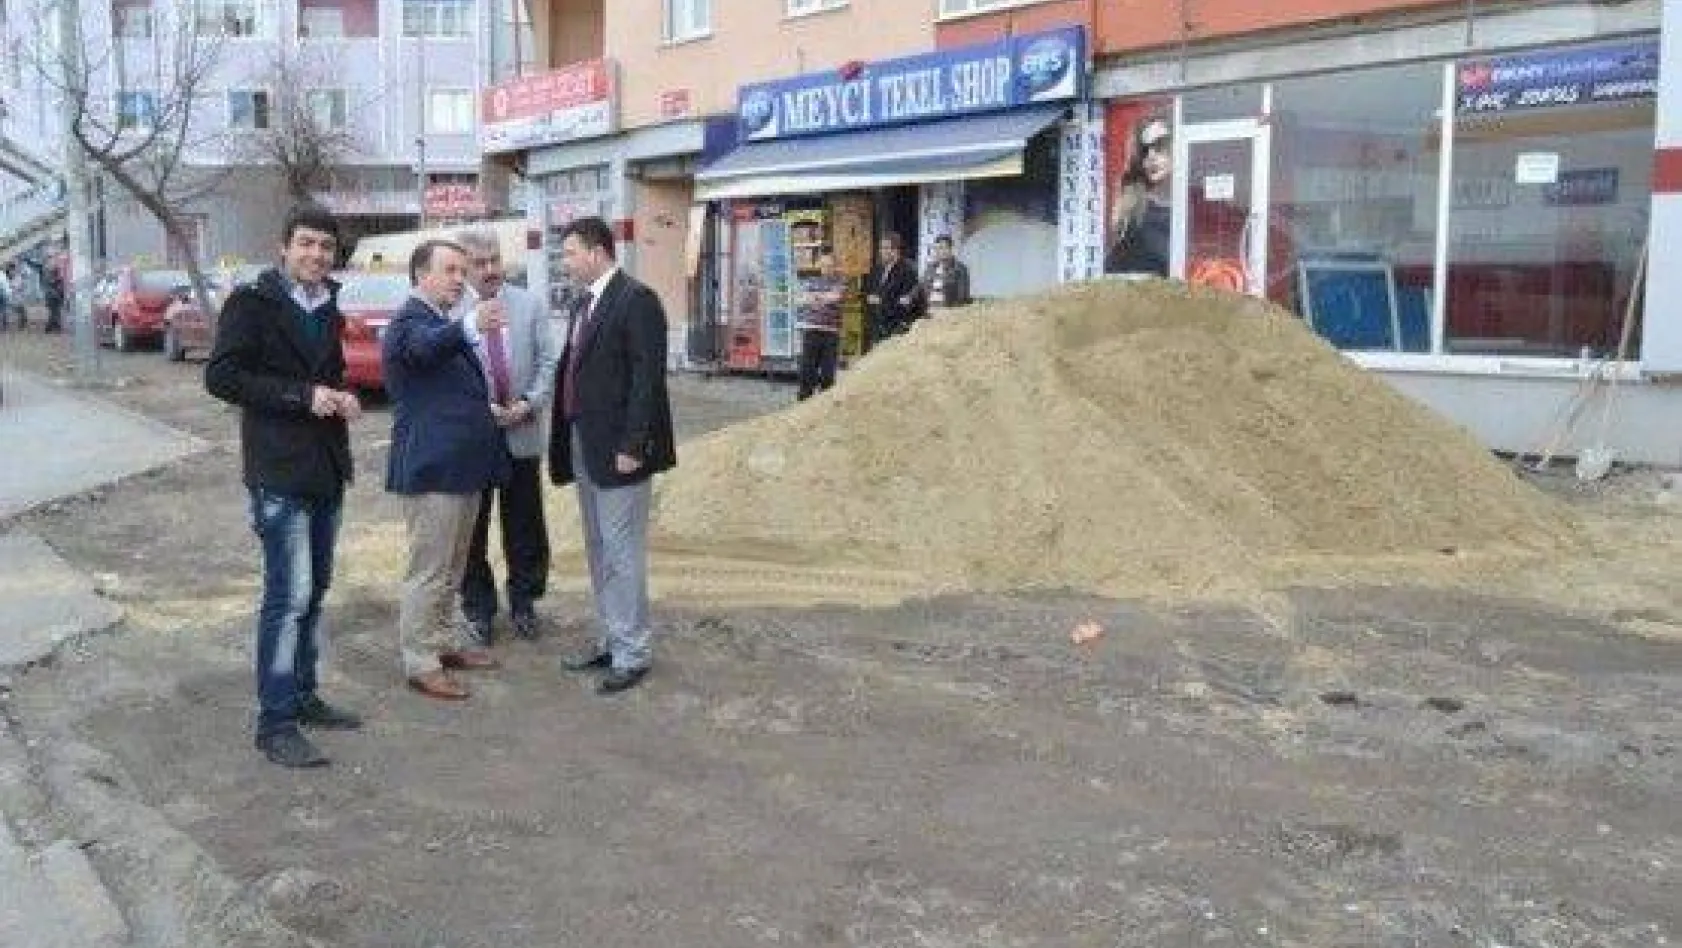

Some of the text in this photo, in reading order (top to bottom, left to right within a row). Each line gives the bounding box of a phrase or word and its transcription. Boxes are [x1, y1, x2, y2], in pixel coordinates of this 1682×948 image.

[783, 58, 1010, 130] MEYCİ TEKEL SHOP
